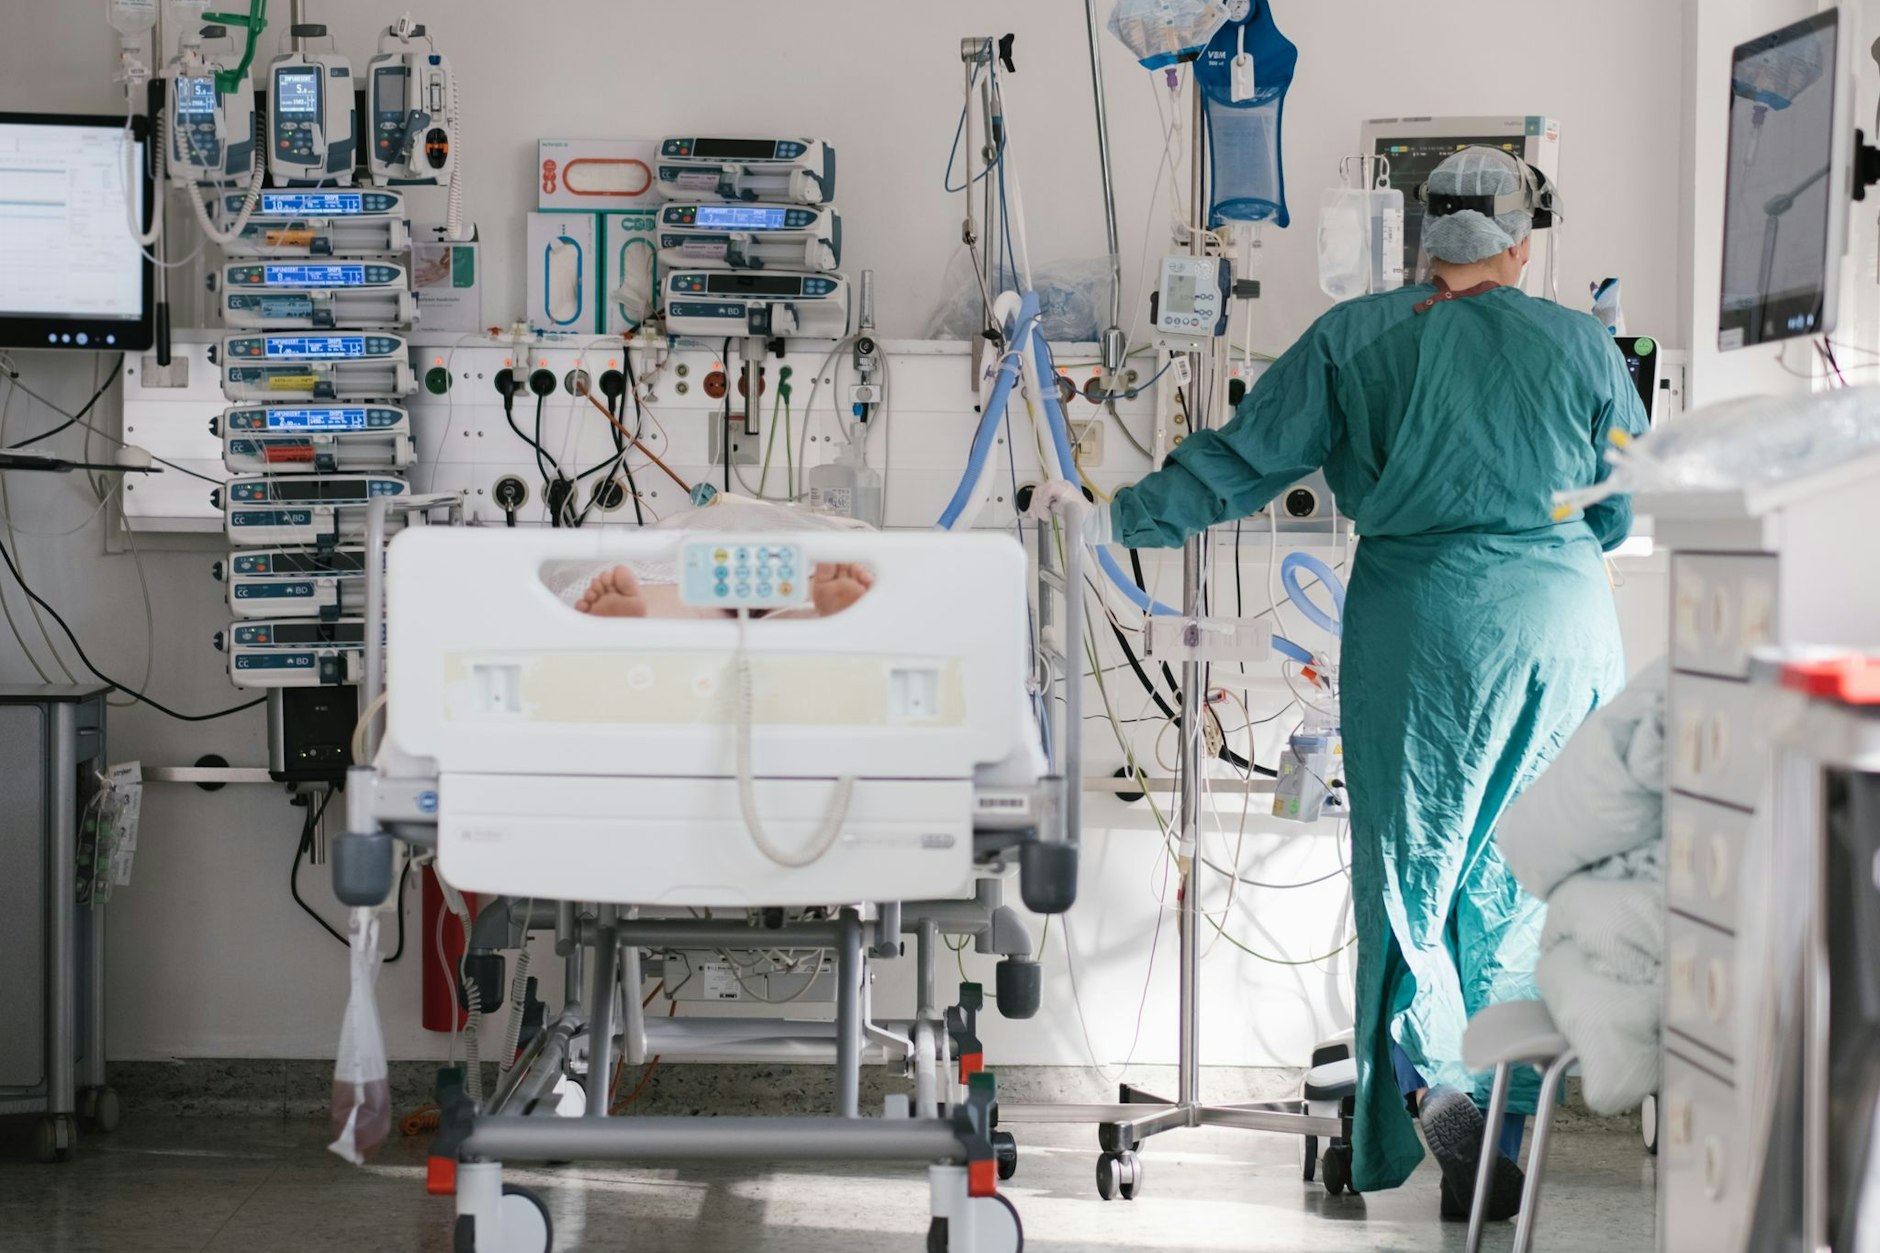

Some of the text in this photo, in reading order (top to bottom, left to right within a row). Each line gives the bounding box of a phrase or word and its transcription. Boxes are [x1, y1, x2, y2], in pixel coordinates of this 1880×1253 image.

[1208, 50, 1226, 59] VBM
[663, 239, 673, 247] CC
[231, 300, 242, 308] CC
[727, 308, 740, 316] BD
[232, 444, 244, 452] CC
[234, 517, 245, 525] CC
[293, 513, 305, 522] BD
[237, 589, 248, 597] CC
[295, 586, 308, 594] BD
[238, 659, 249, 668] CC
[296, 657, 309, 666] BD
[113, 768, 132, 777] stryker
[123, 794, 130, 805] 3
